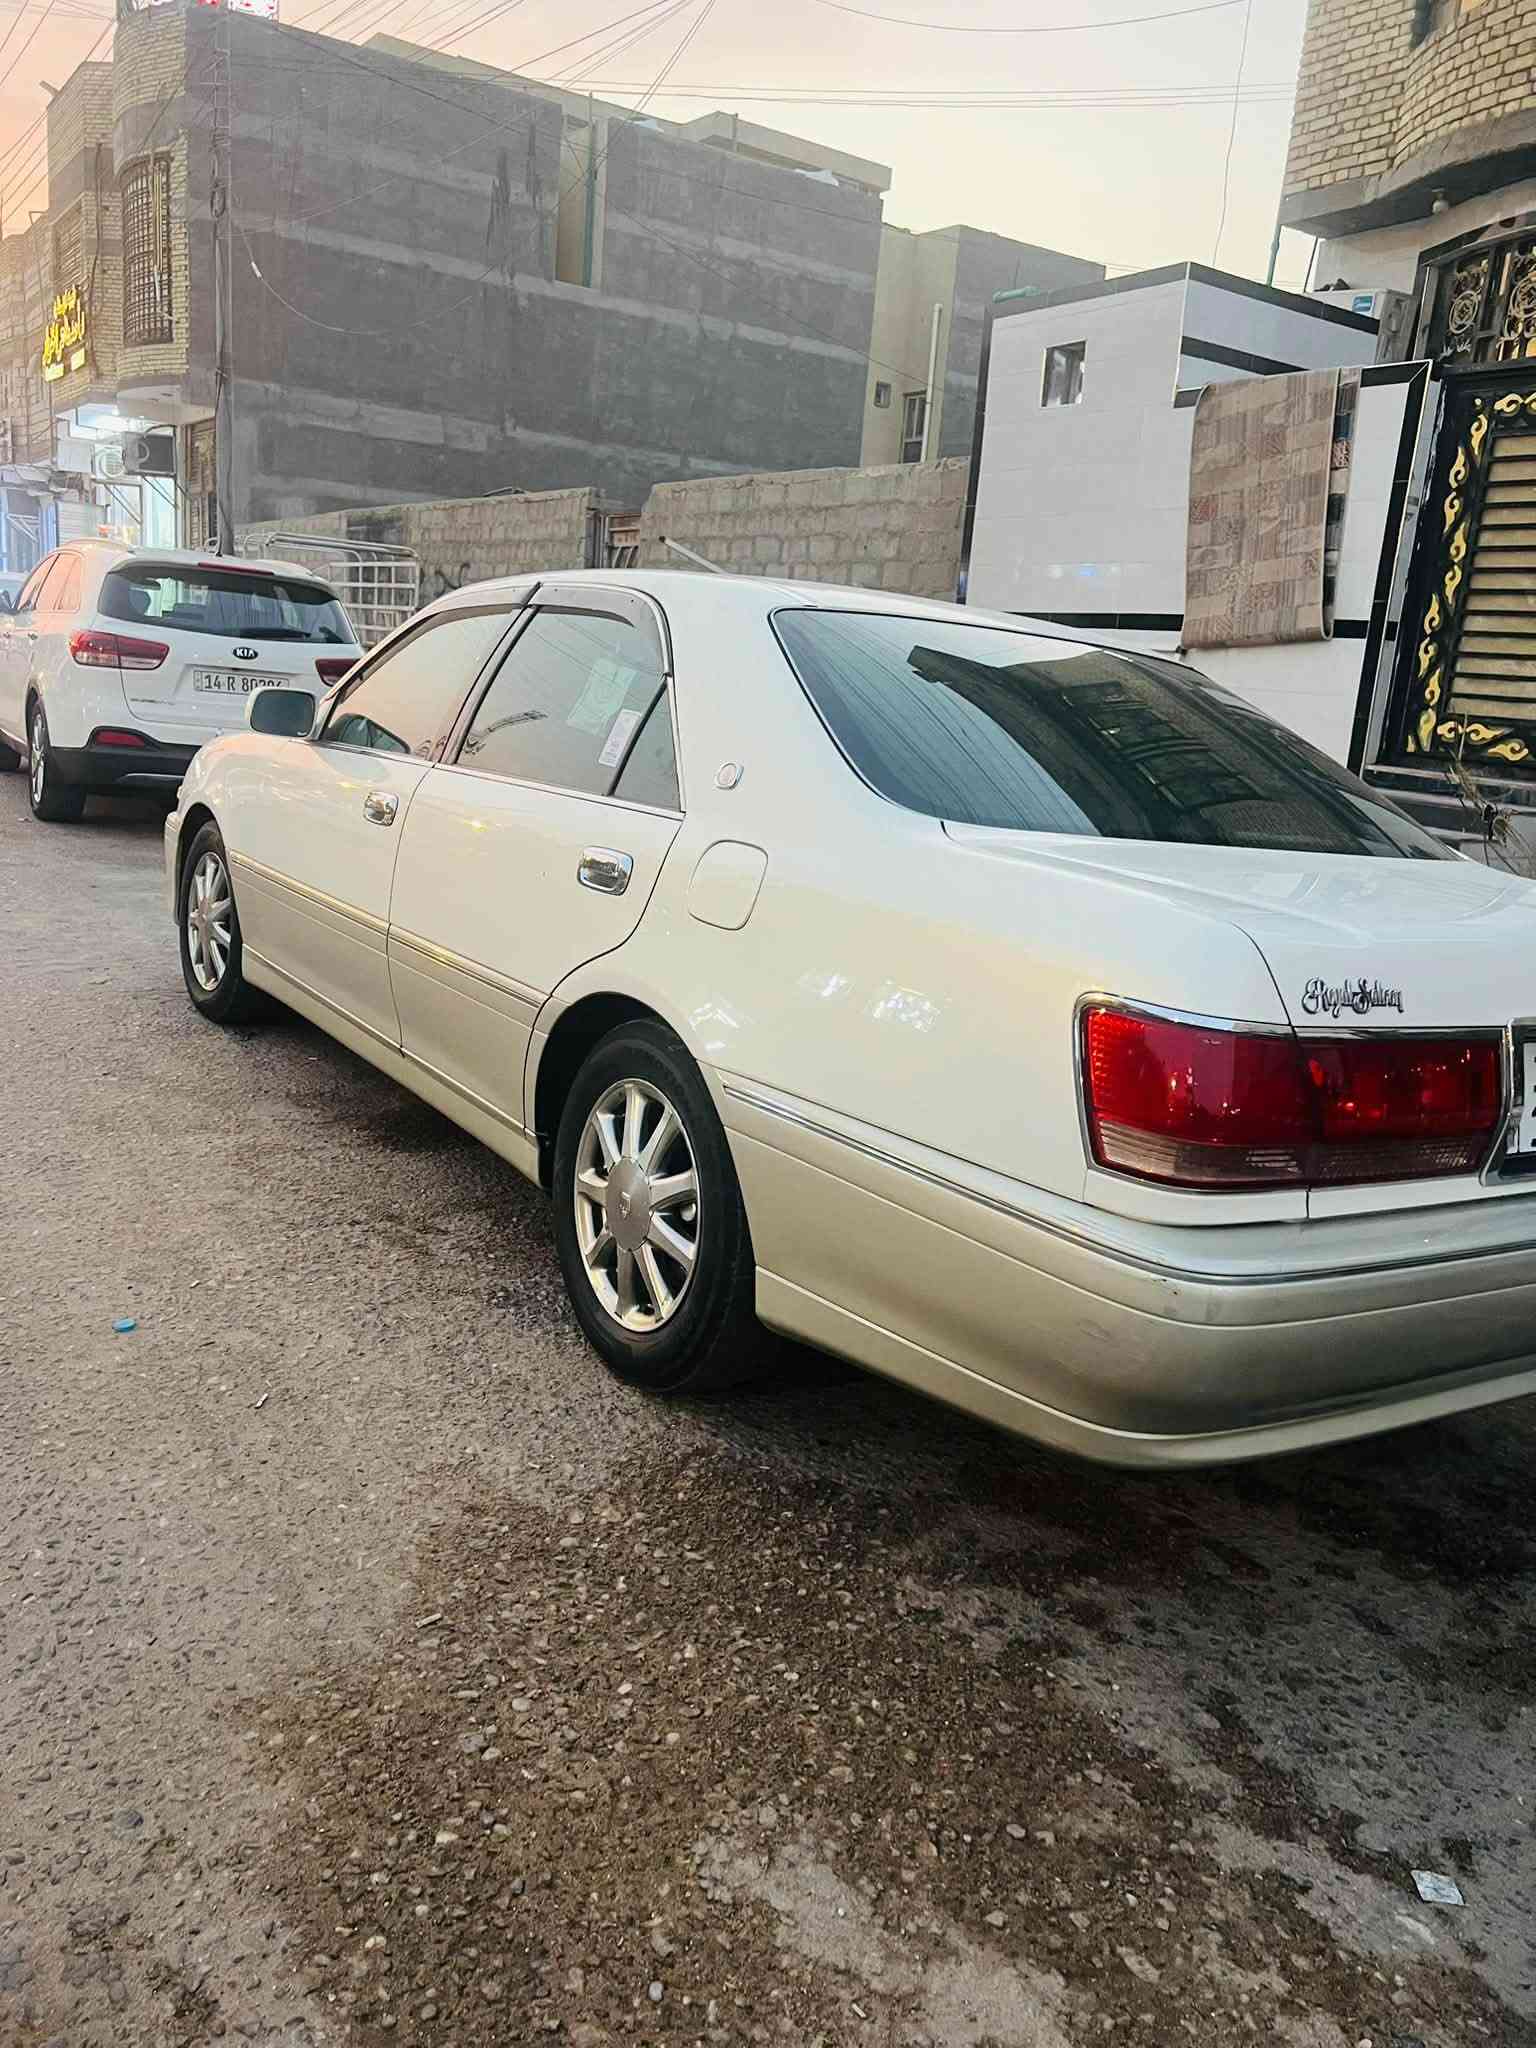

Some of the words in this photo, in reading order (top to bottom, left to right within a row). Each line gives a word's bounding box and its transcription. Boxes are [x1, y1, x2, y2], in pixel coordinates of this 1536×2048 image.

[236, 648, 255, 658] KIA
[204, 674, 221, 690] 14
[227, 676, 236, 691] R
